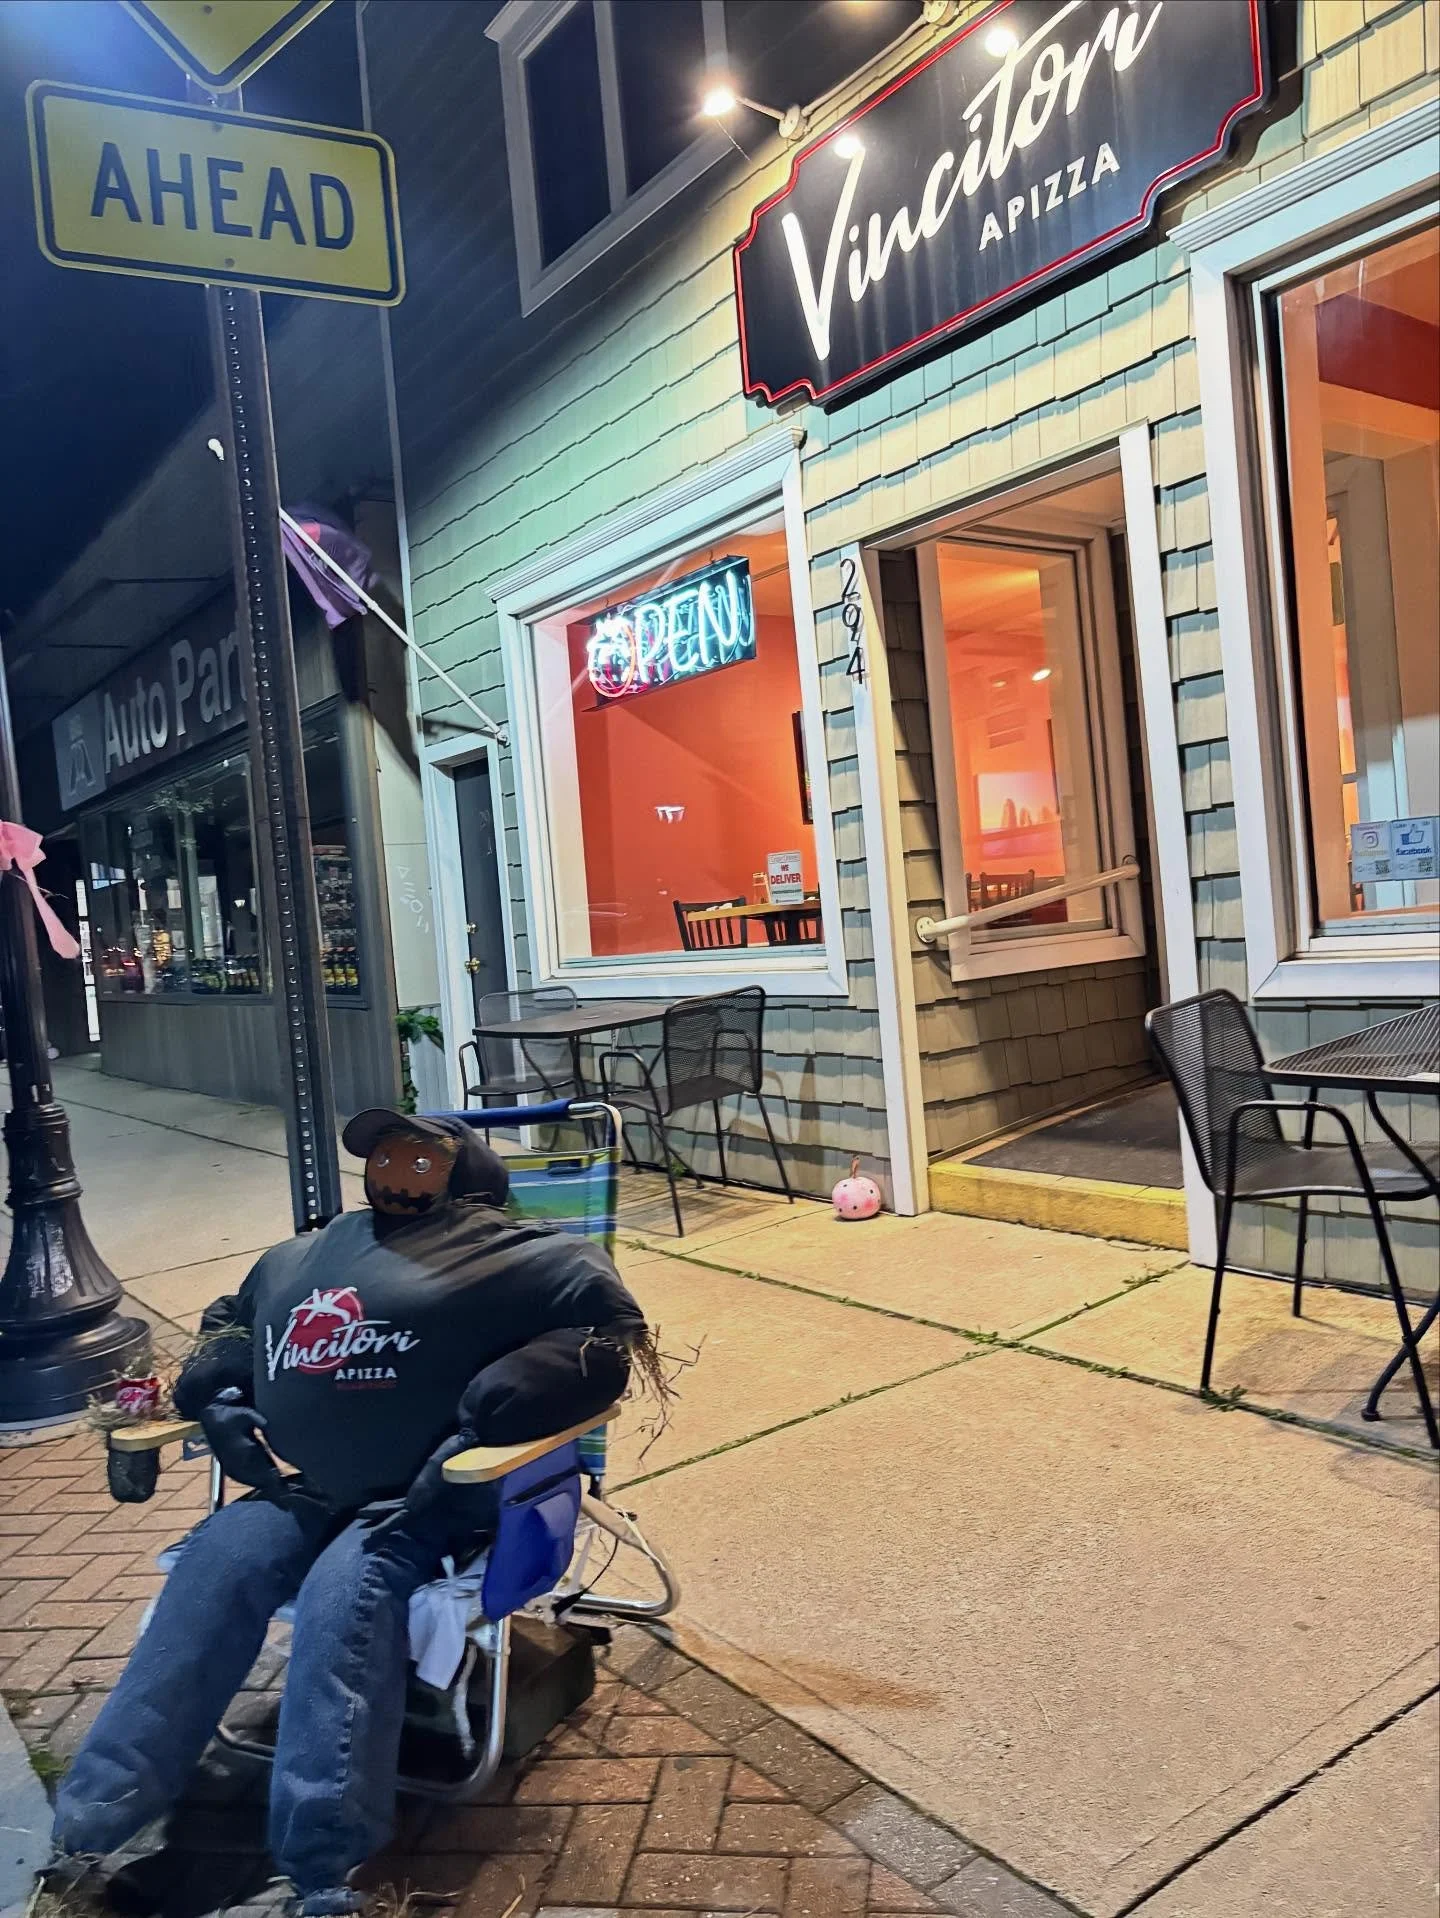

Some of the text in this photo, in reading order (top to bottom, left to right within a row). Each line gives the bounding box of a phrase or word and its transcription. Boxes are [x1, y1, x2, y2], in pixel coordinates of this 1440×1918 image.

[91, 141, 355, 250] AHEAD
[782, 0, 1163, 360] Vincitori
[979, 142, 1121, 251] APIZZA
[586, 569, 739, 698] OPEN
[840, 558, 866, 685] 294
[104, 676, 168, 774] Auto
[771, 873, 801, 884] DELIVER
[781, 864, 789, 872] WE
[265, 1319, 421, 1381] Vincitori
[334, 1367, 397, 1380] APIZZA
